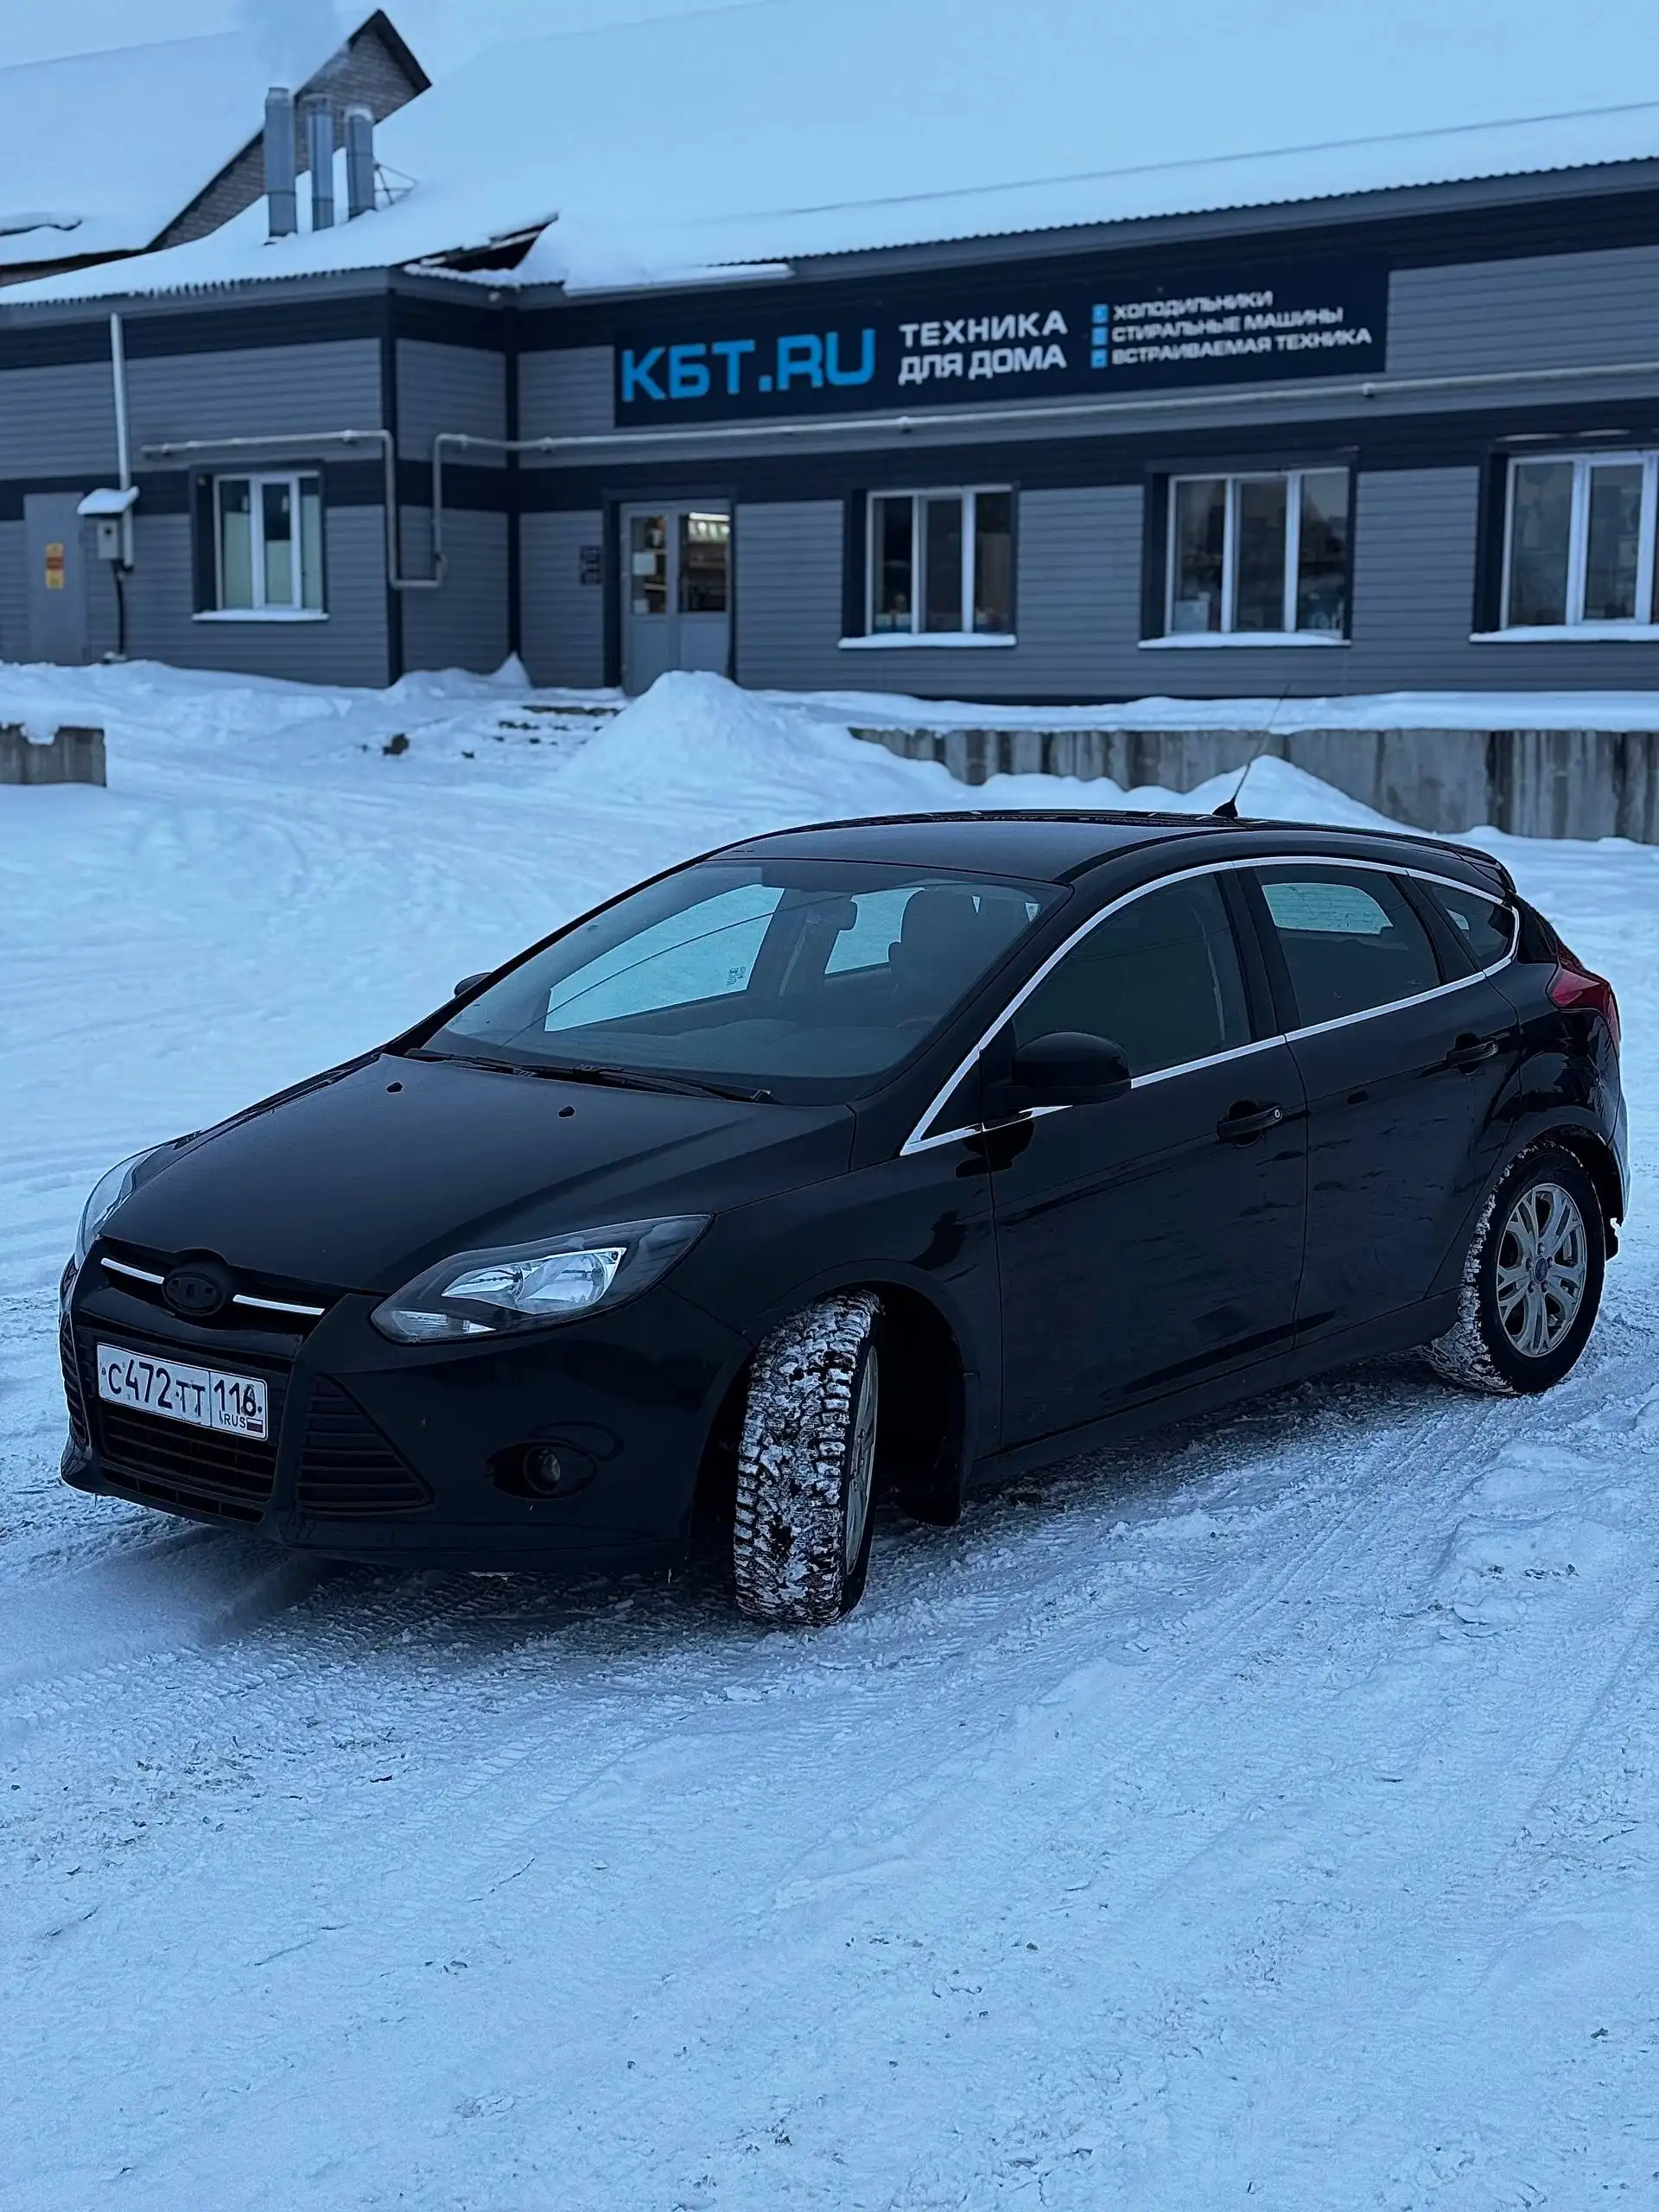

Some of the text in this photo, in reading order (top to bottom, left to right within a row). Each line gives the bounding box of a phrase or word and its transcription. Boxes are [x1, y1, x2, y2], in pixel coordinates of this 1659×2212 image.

[1114, 290, 1274, 321] ХОЛОДИЛЬНИКИ
[899, 310, 1068, 349] ТЕХНИКА
[1112, 308, 1344, 342] СТИРАЛЬНЫЕ МАШИНЫ
[898, 344, 1068, 385] ДЛЯ ДОМА
[1112, 327, 1372, 365] ВСТРАИВАЕМАЯ ТЕХНИКА
[621, 328, 876, 403] КБТ.RU
[223, 1412, 247, 1429] RUS
